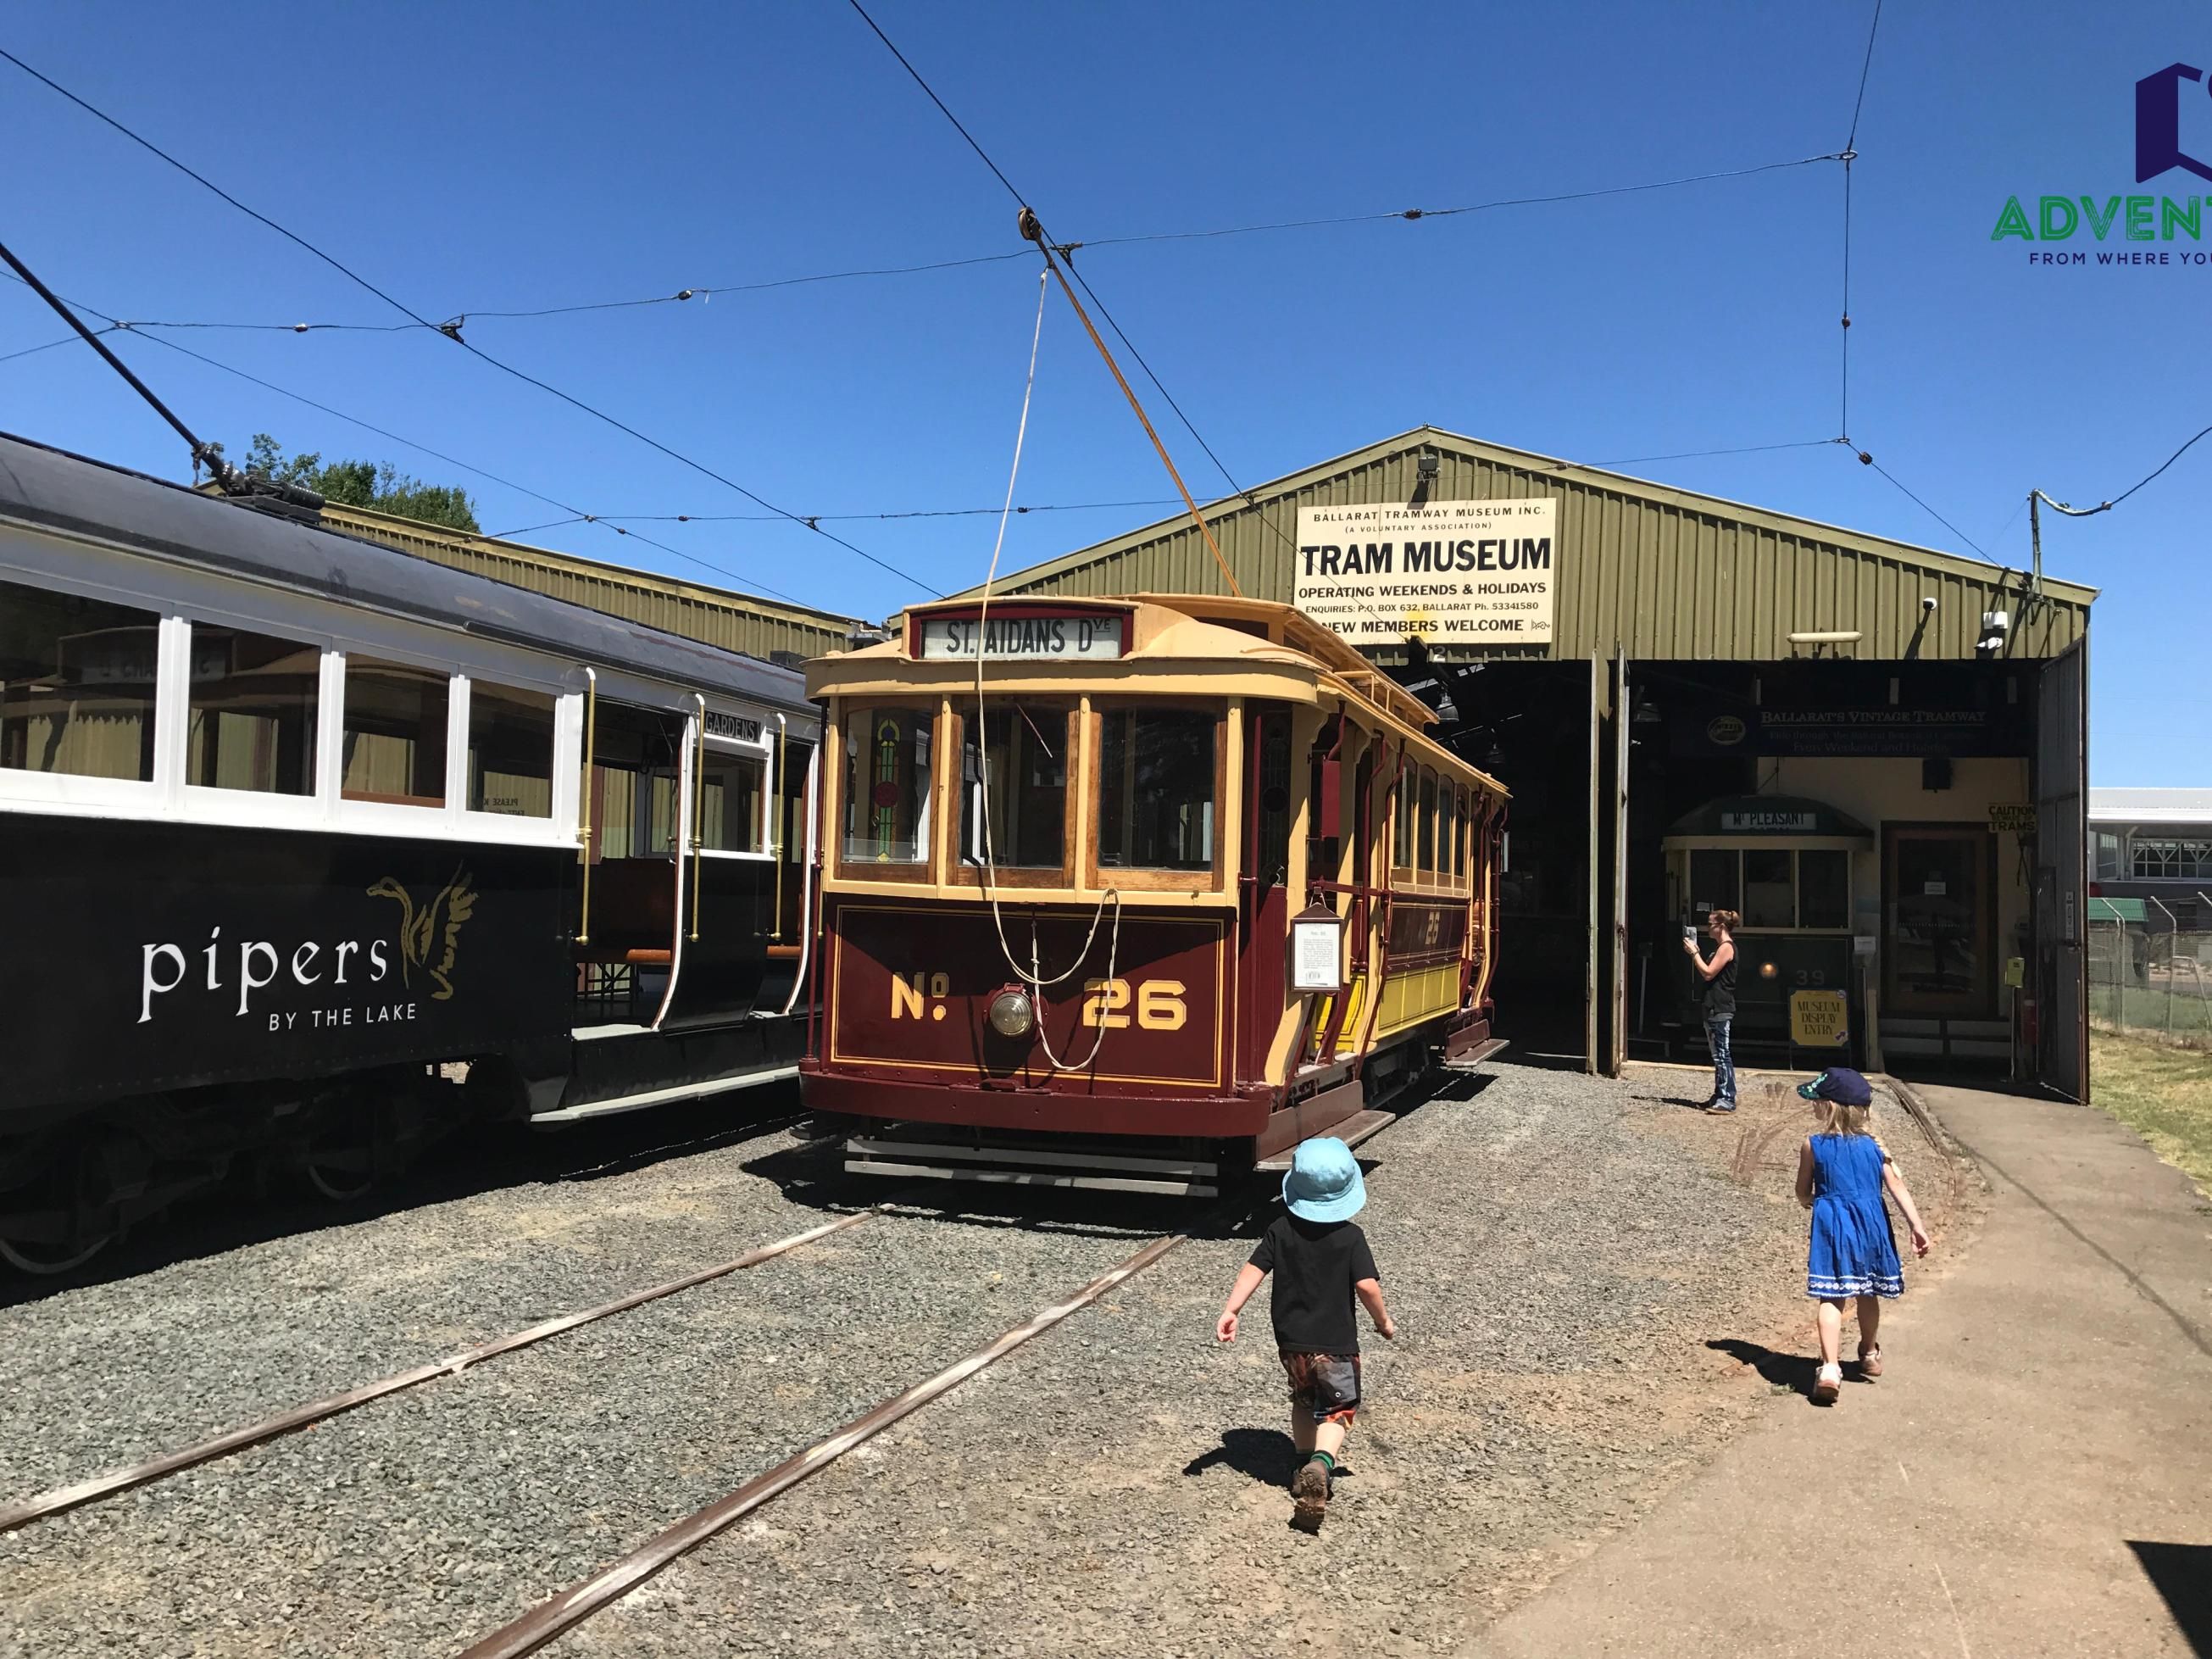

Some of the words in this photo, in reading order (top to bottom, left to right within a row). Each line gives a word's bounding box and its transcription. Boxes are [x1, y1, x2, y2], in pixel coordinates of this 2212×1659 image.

[1314, 511, 1378, 522] BALLARAT
[1385, 509, 1449, 520] TRAMWAY
[1455, 507, 1512, 517] MUSEUM
[1518, 506, 1546, 515] INC.
[1345, 526, 1354, 534] (A
[1360, 524, 1415, 532] VOLUNTARY
[1420, 522, 1492, 532] ASSOCIATION)
[1300, 543, 1392, 576] TRAM
[1403, 537, 1551, 573] MUSEUM
[1298, 587, 1375, 598] OPERATING
[1379, 584, 1458, 597] WEEKENDS
[1463, 584, 1473, 595] &
[1477, 582, 1547, 595] HOLIDAYS
[1305, 604, 1356, 614] ENQUIRIES:
[1378, 604, 1397, 612] BOX
[1400, 603, 1420, 613] 632,
[1423, 603, 1471, 611] BALLARAT
[1474, 602, 1489, 611] Ph.
[1492, 602, 1539, 610] 53341580
[1361, 620, 1439, 632] MEMBERS
[1444, 619, 1524, 632] WELCOME
[947, 621, 975, 654] ST.
[984, 618, 1065, 654] AIDANS
[1433, 645, 1446, 663] 2
[705, 712, 755, 742] GARDENS
[1824, 740, 1878, 753] Weekend
[1881, 741, 1903, 753] and
[1988, 805, 2037, 816] CAUTION
[1750, 813, 1804, 826] PLEASANT
[1988, 821, 2036, 832] TRAMS
[136, 926, 389, 1024] pipers
[1796, 969, 1825, 985] 39
[1082, 977, 1187, 1031] 26
[1797, 1000, 1840, 1012] MUSEUM
[268, 1011, 297, 1032] BY
[311, 1008, 352, 1029] THE
[366, 1003, 416, 1024] LAKE
[1802, 1012, 1837, 1023] DISPLAY
[1804, 1023, 1833, 1035] ENTRY
